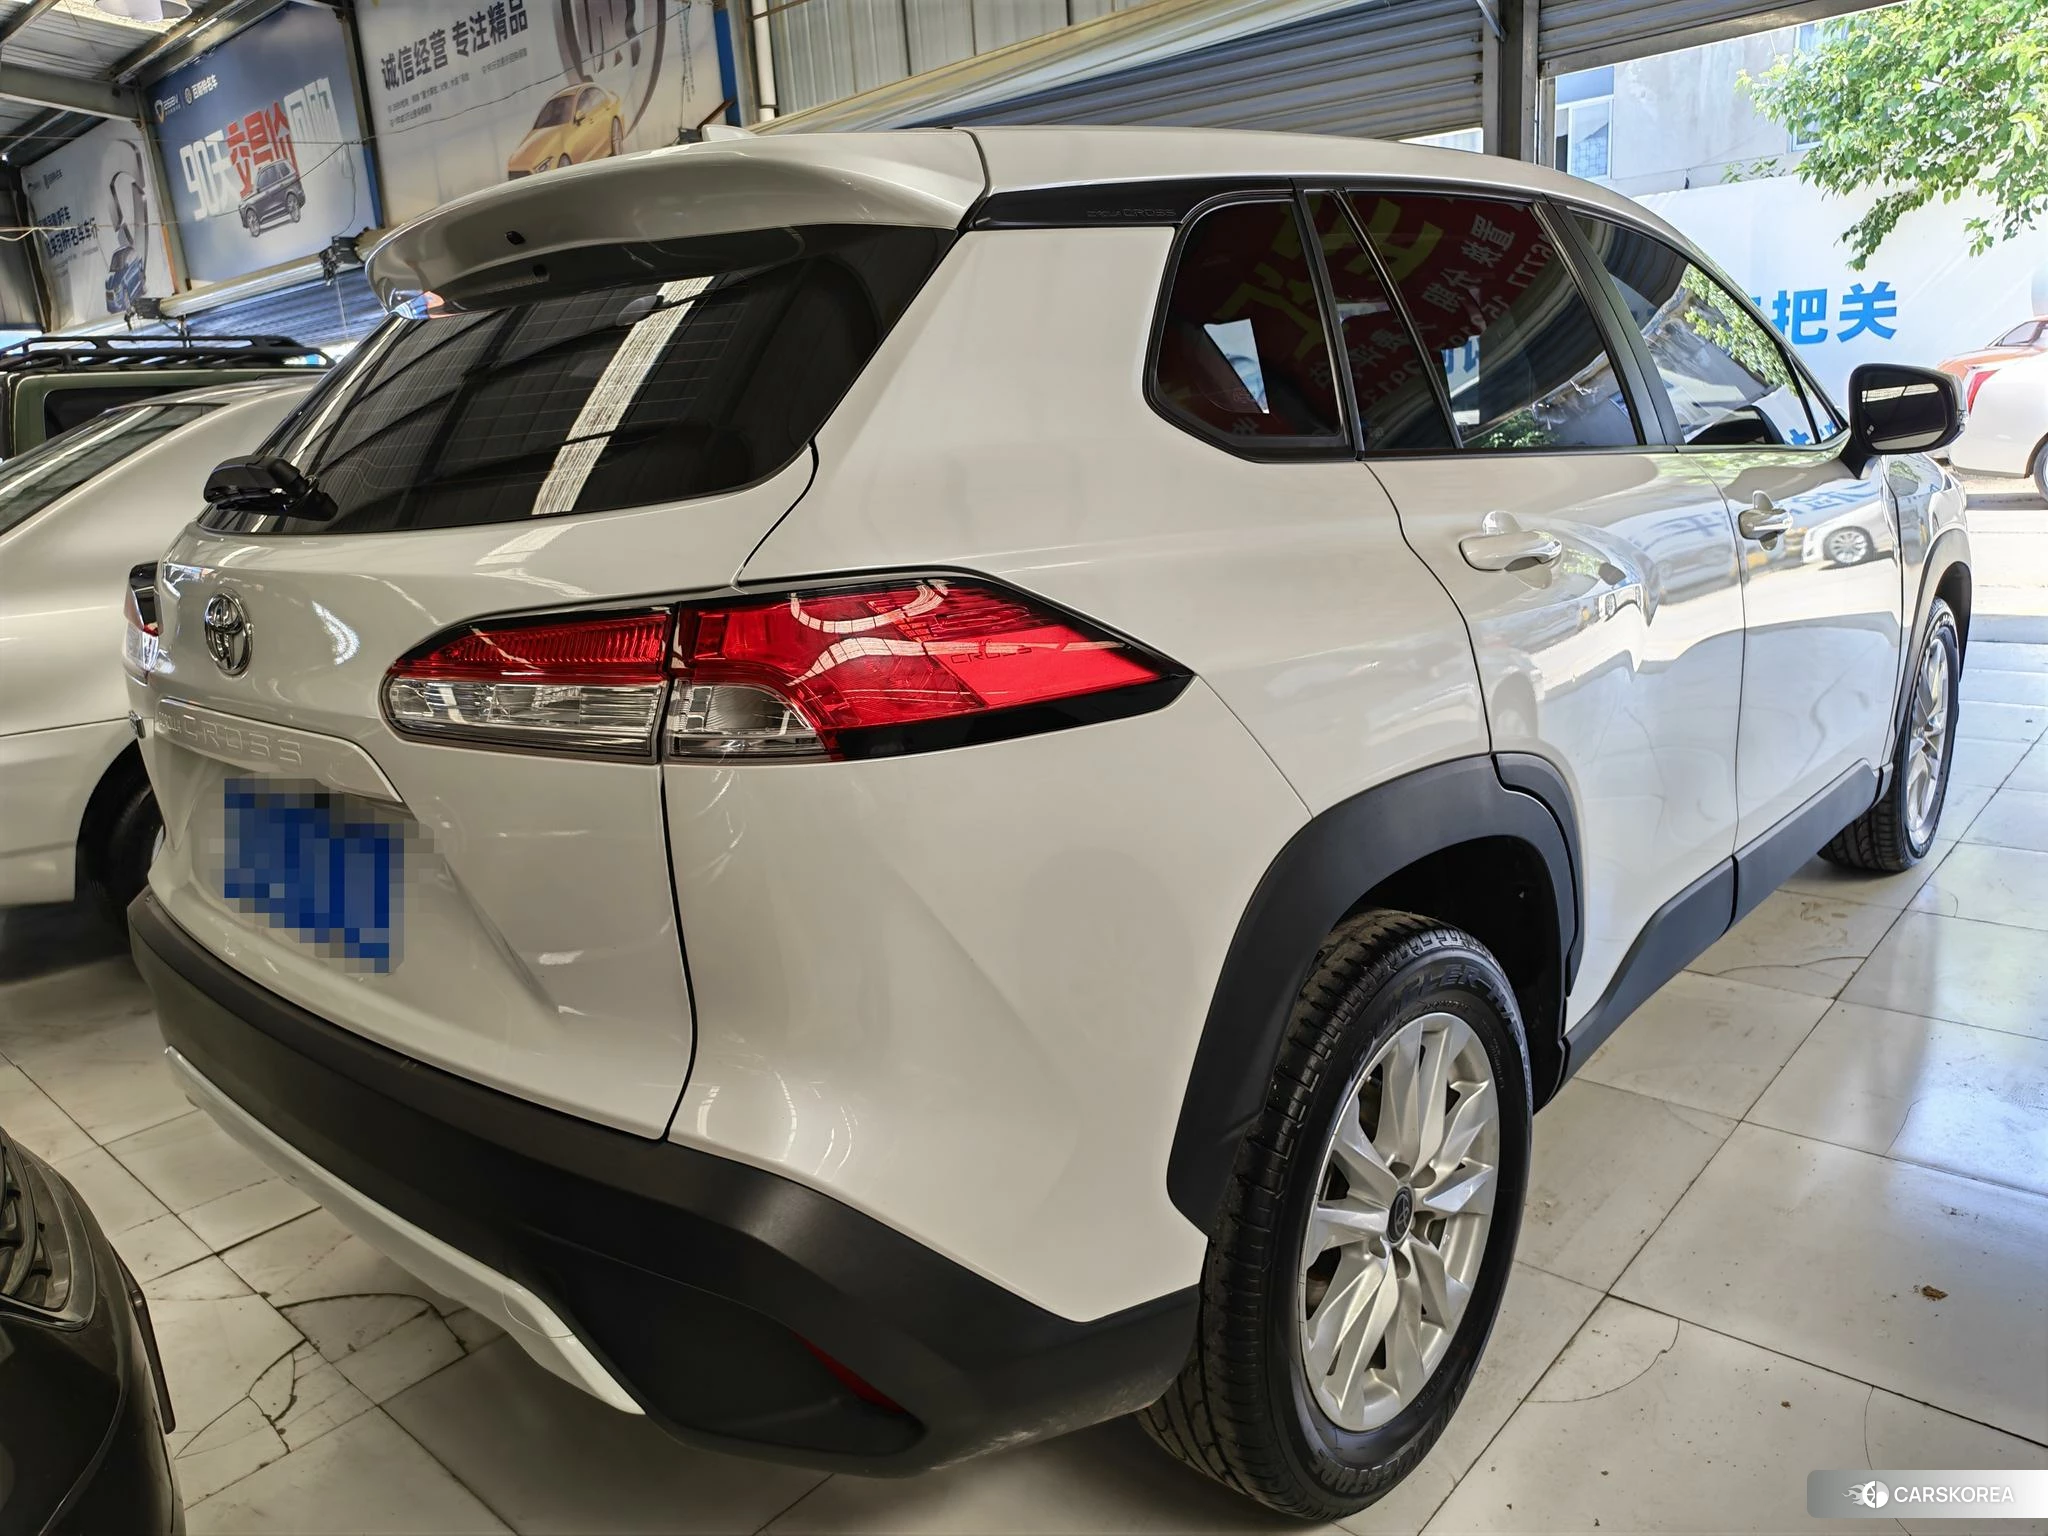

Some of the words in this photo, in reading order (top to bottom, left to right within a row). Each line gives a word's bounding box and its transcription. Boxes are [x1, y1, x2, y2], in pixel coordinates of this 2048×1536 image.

[380, 29, 448, 92] 诚信经营
[452, 0, 528, 57] 专注精品
[1752, 281, 1898, 345] 把关
